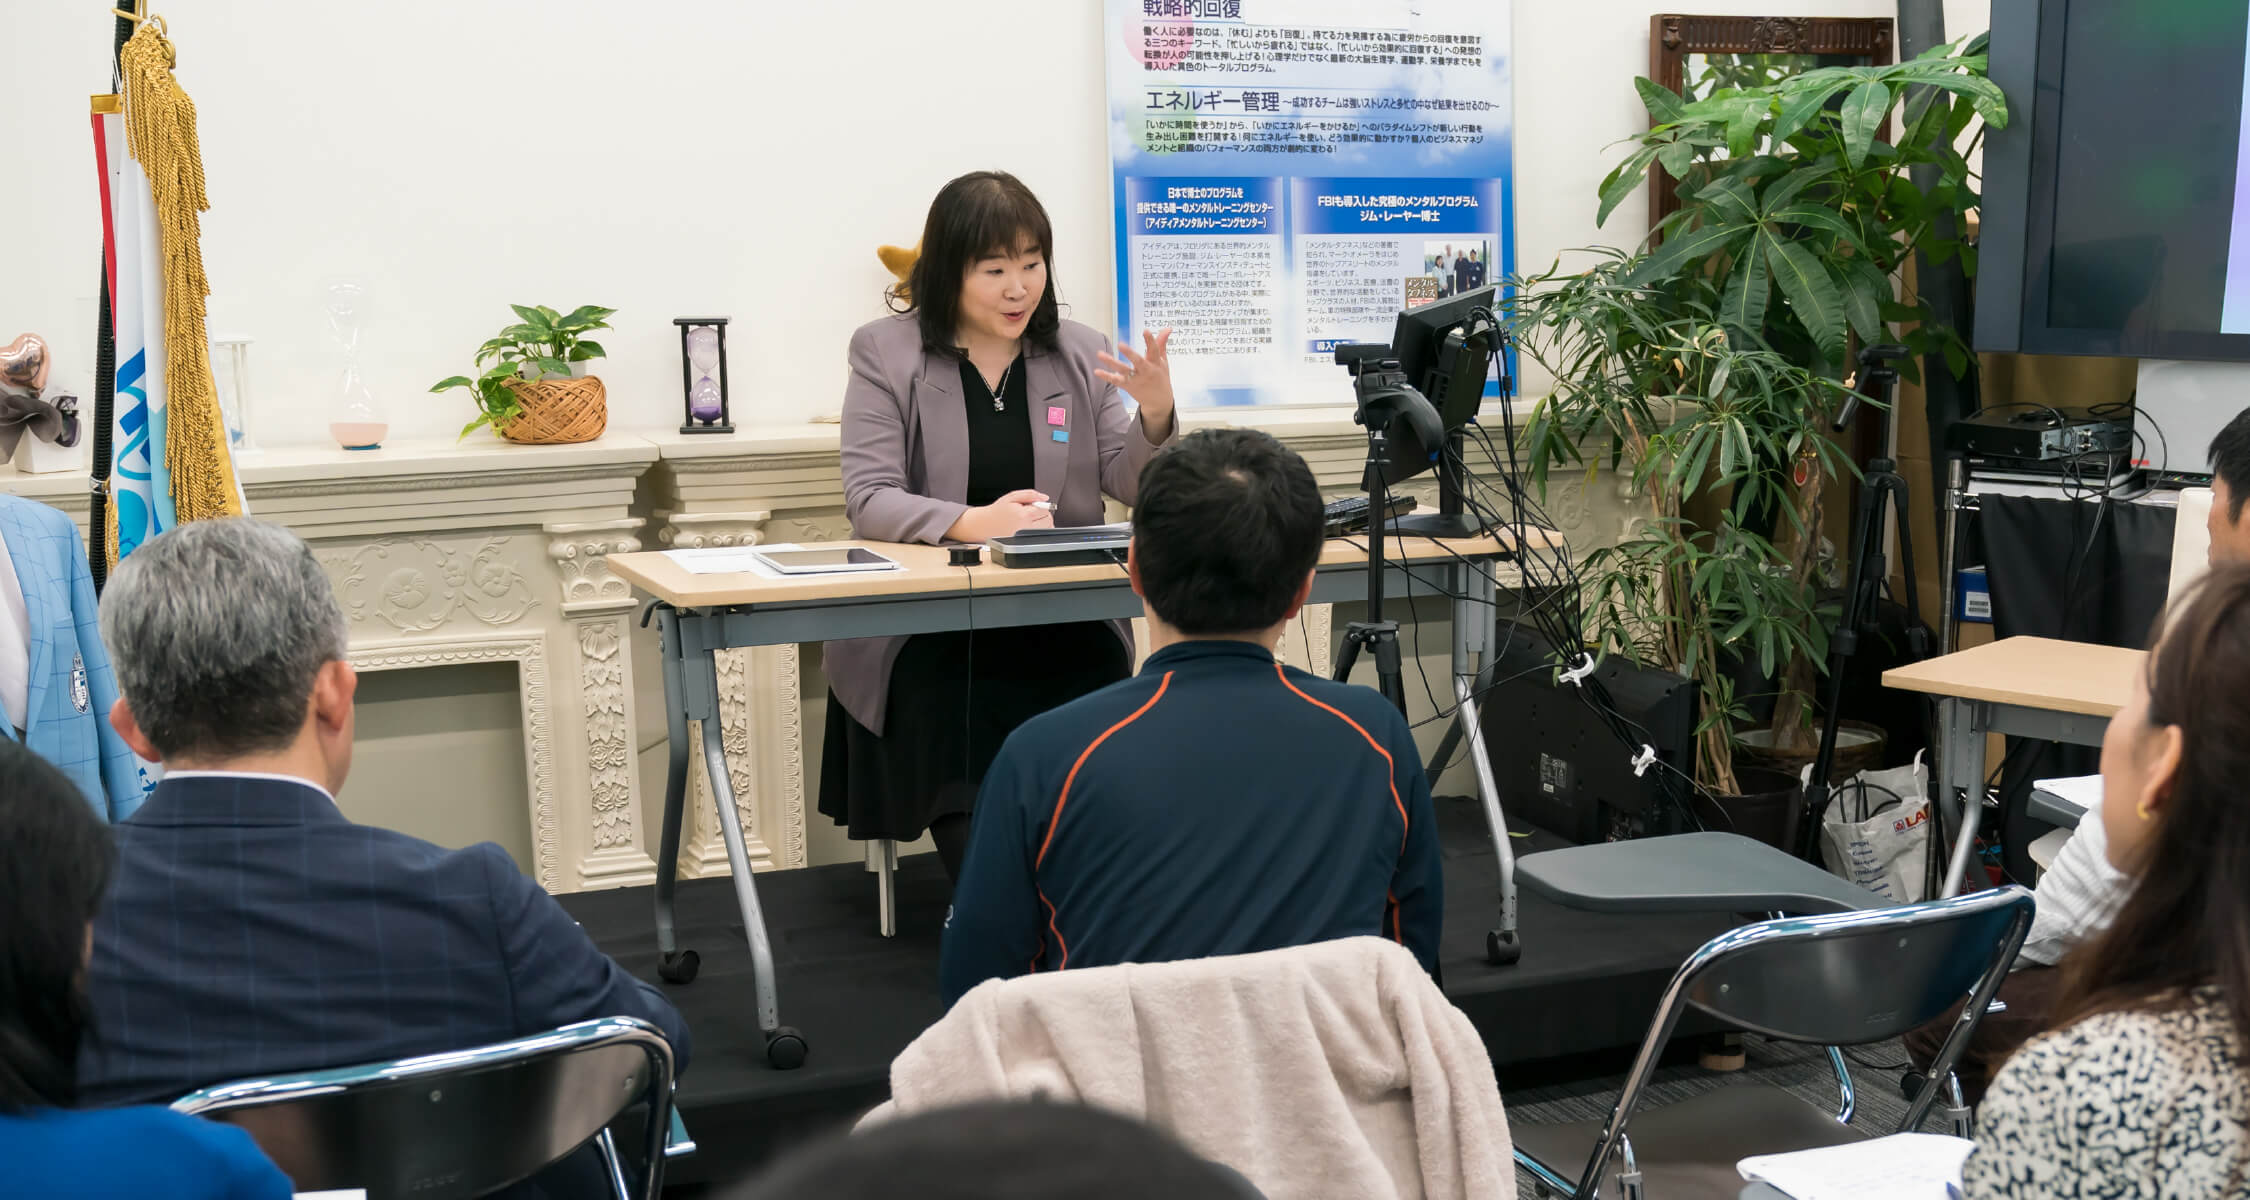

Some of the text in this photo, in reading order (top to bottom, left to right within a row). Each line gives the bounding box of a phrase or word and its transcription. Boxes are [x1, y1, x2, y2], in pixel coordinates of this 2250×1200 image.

[1146, 91, 1280, 112] エネルギー管理
